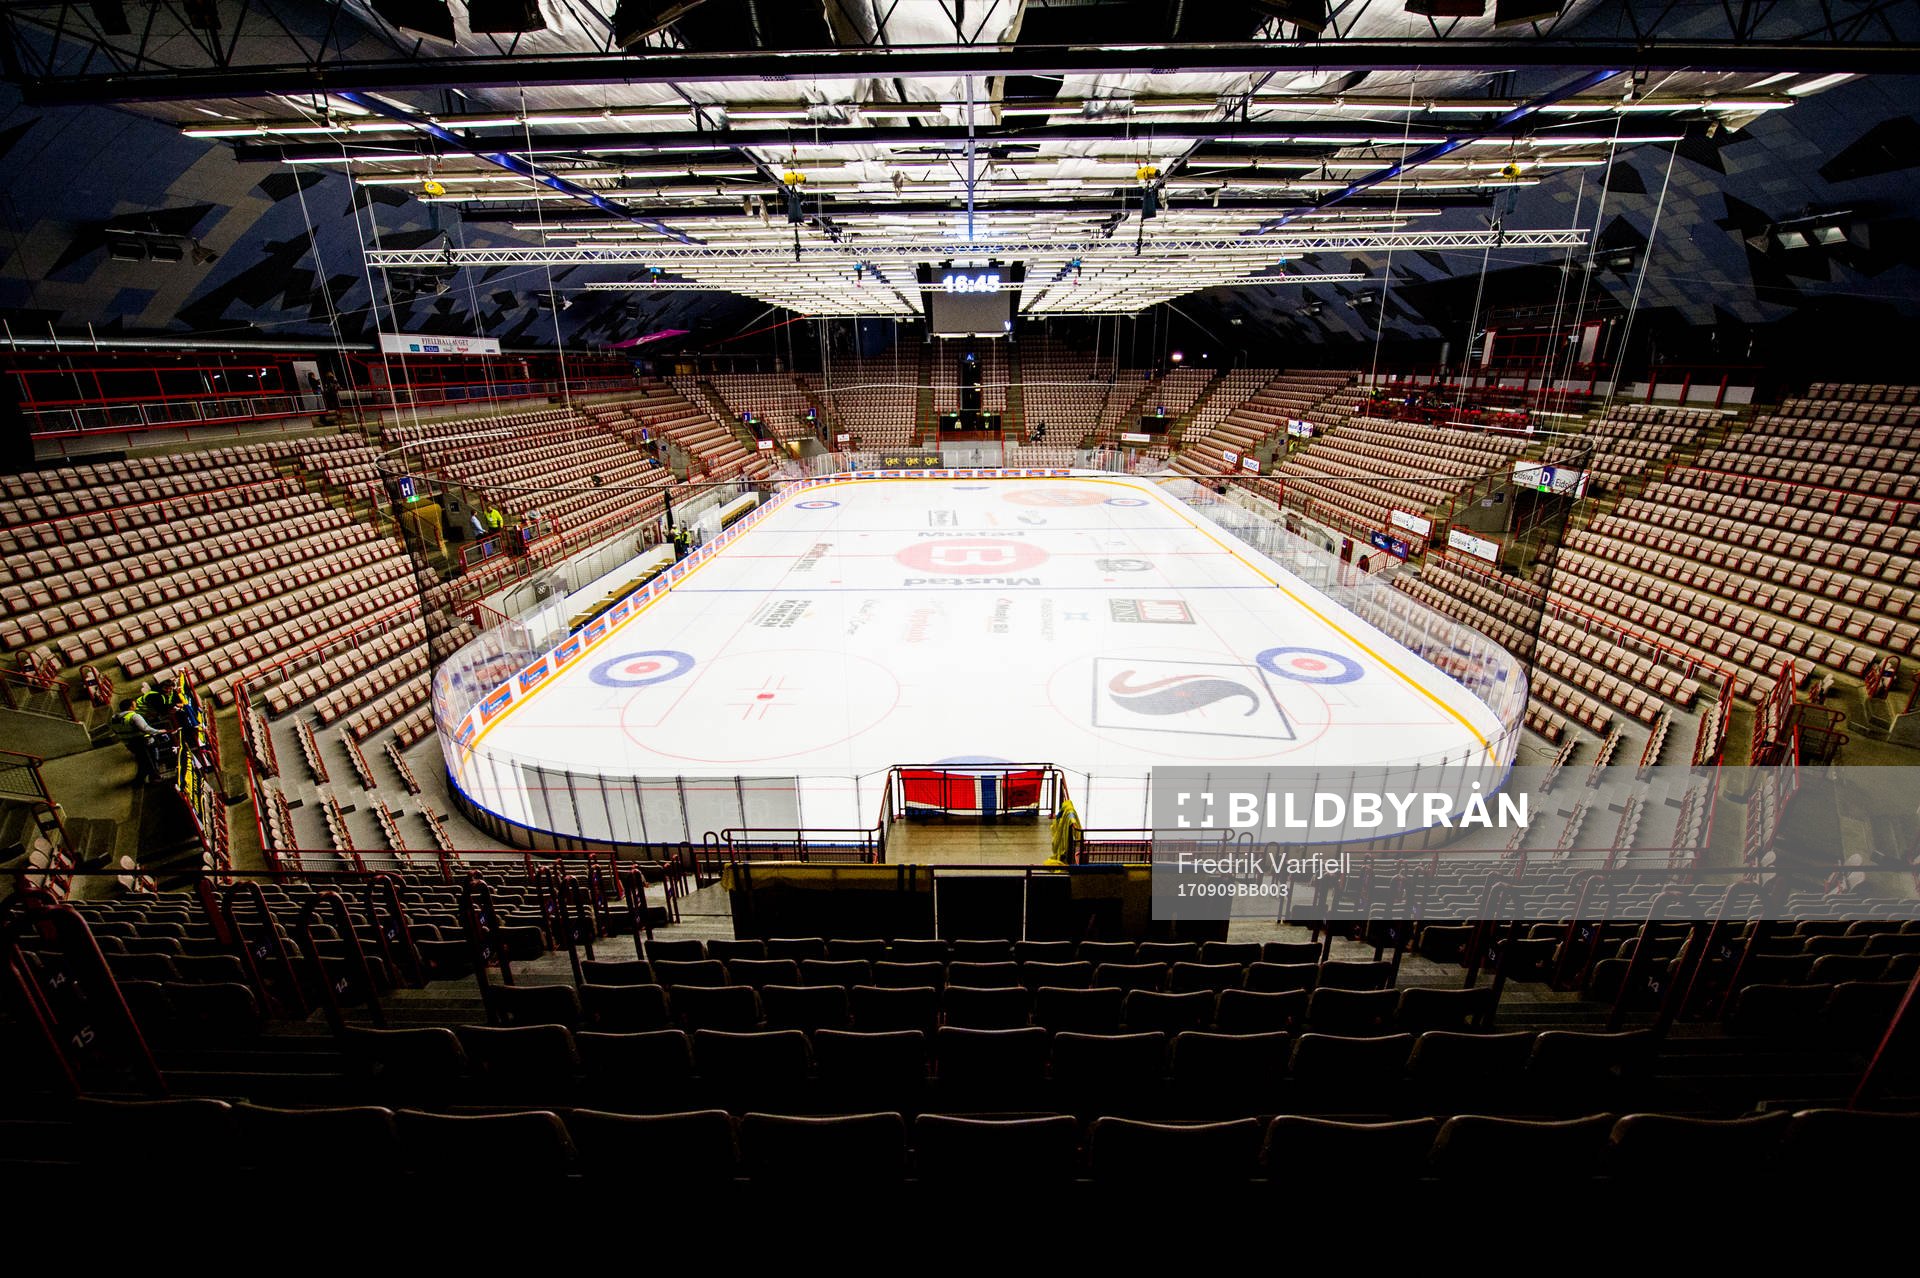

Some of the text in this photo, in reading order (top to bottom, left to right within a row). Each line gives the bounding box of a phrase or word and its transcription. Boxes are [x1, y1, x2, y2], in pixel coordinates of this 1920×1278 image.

[943, 275, 1000, 293] 16:45
[1541, 471, 1551, 484] D
[401, 483, 411, 496] H
[903, 577, 1041, 586] Mustad
[760, 599, 799, 628] KONGEN
[256, 943, 272, 959] 13
[1721, 945, 1733, 959] 13
[49, 972, 67, 990] 14
[335, 976, 348, 993] 14
[1647, 976, 1661, 993] 14
[71, 1024, 96, 1048] 15
